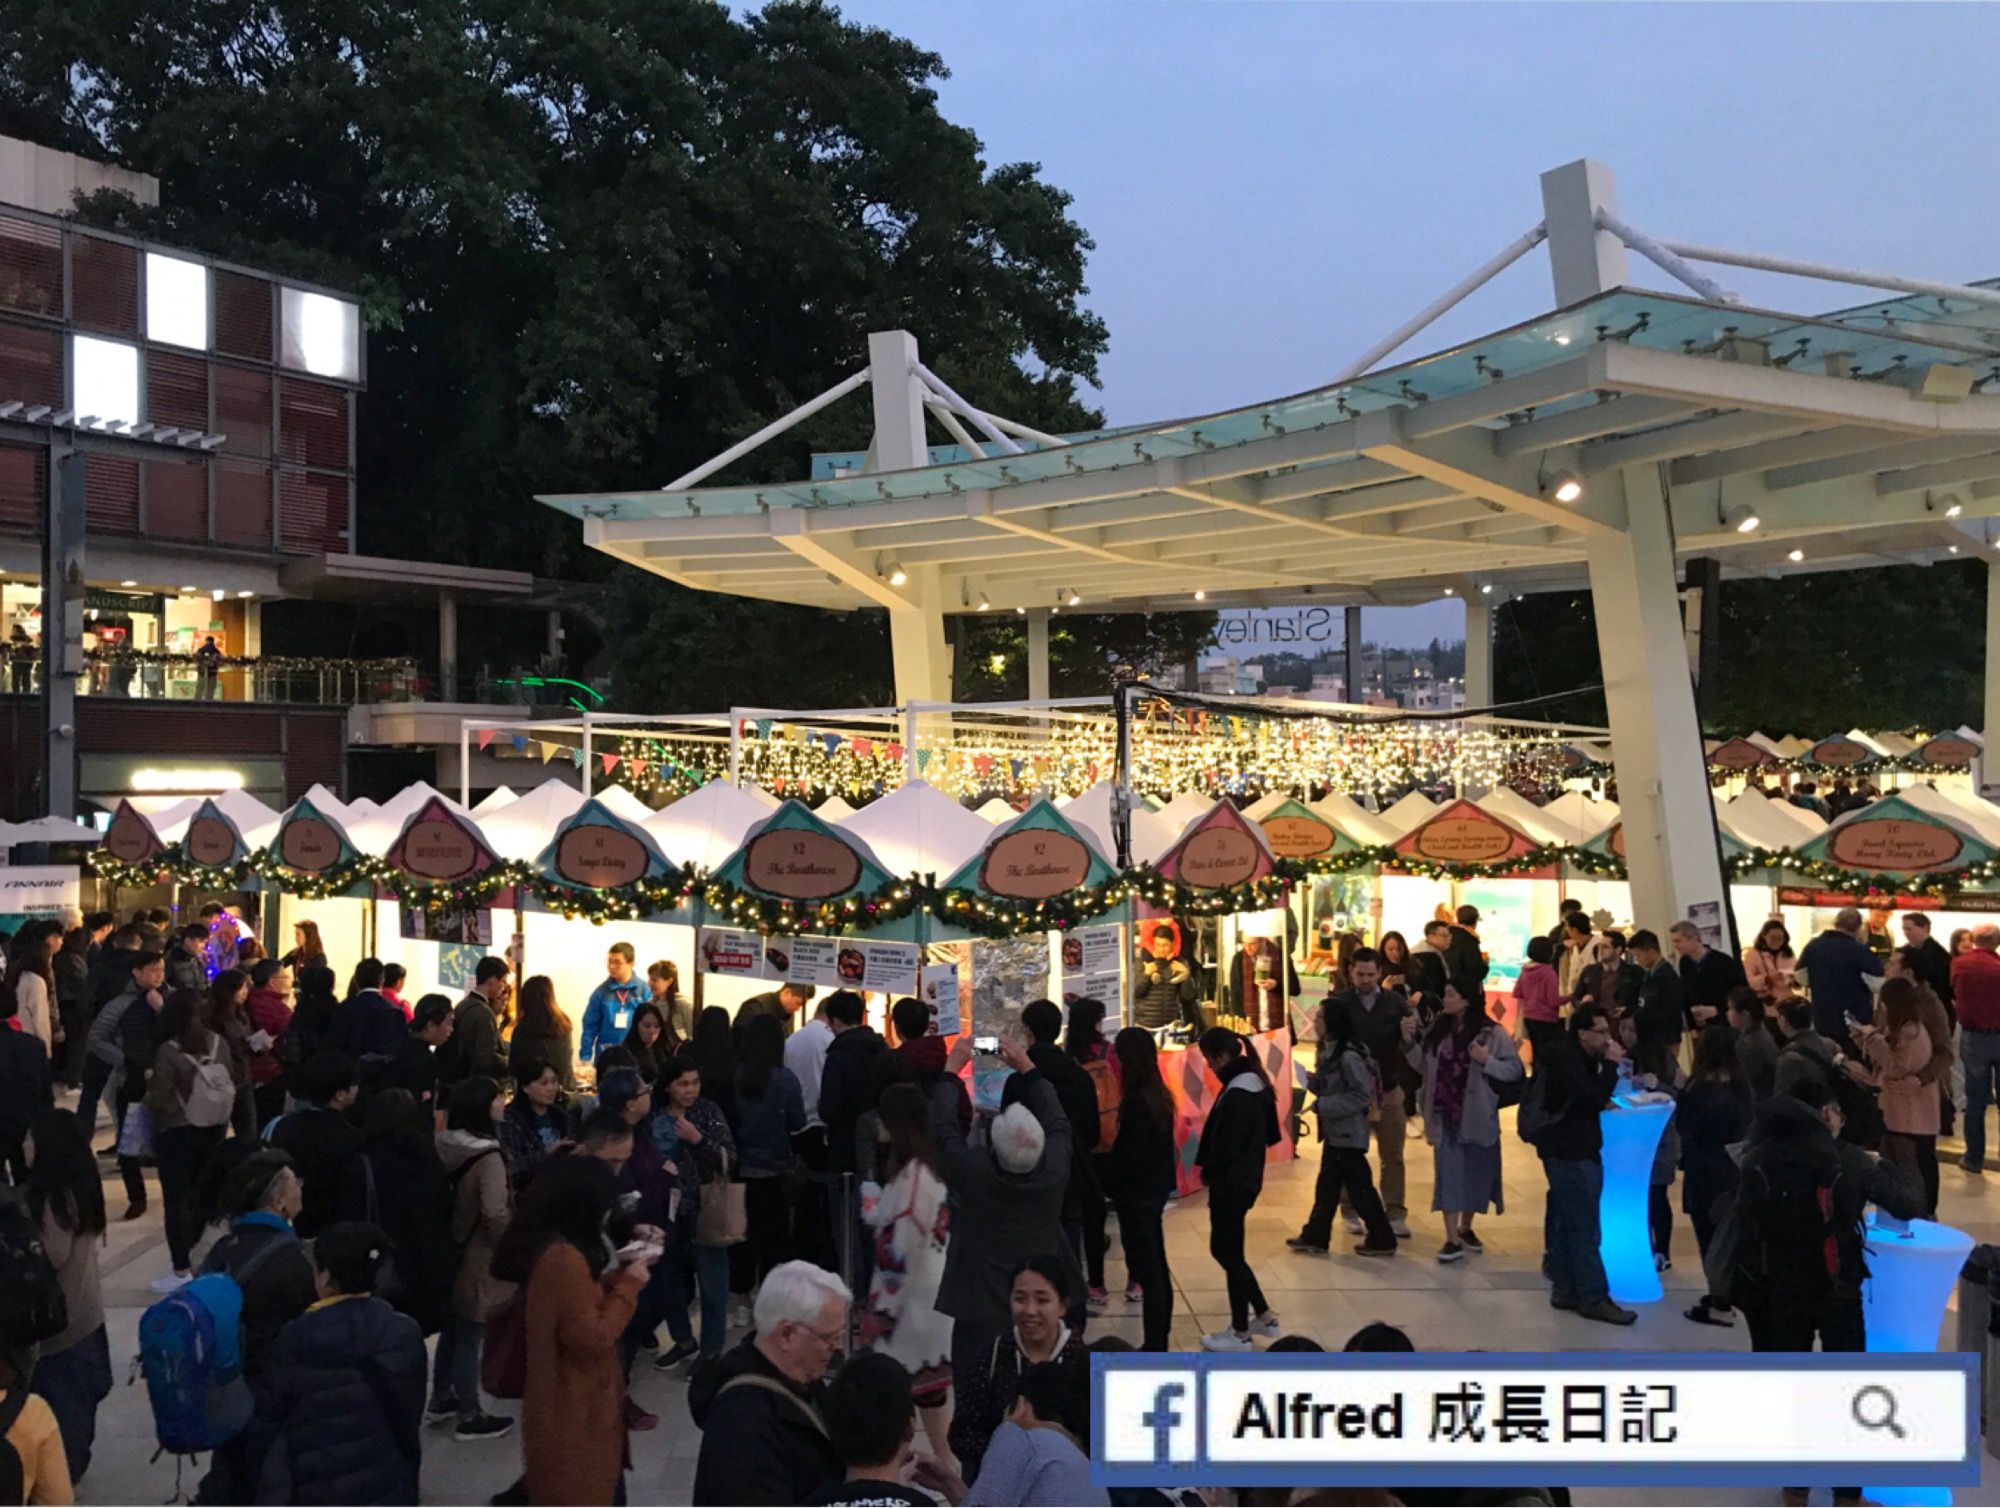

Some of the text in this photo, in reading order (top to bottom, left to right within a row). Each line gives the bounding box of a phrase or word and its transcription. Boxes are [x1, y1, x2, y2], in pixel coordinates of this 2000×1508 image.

[766, 861, 785, 875] The
[1004, 864, 1023, 878] The
[4, 880, 65, 888] FINNAIR
